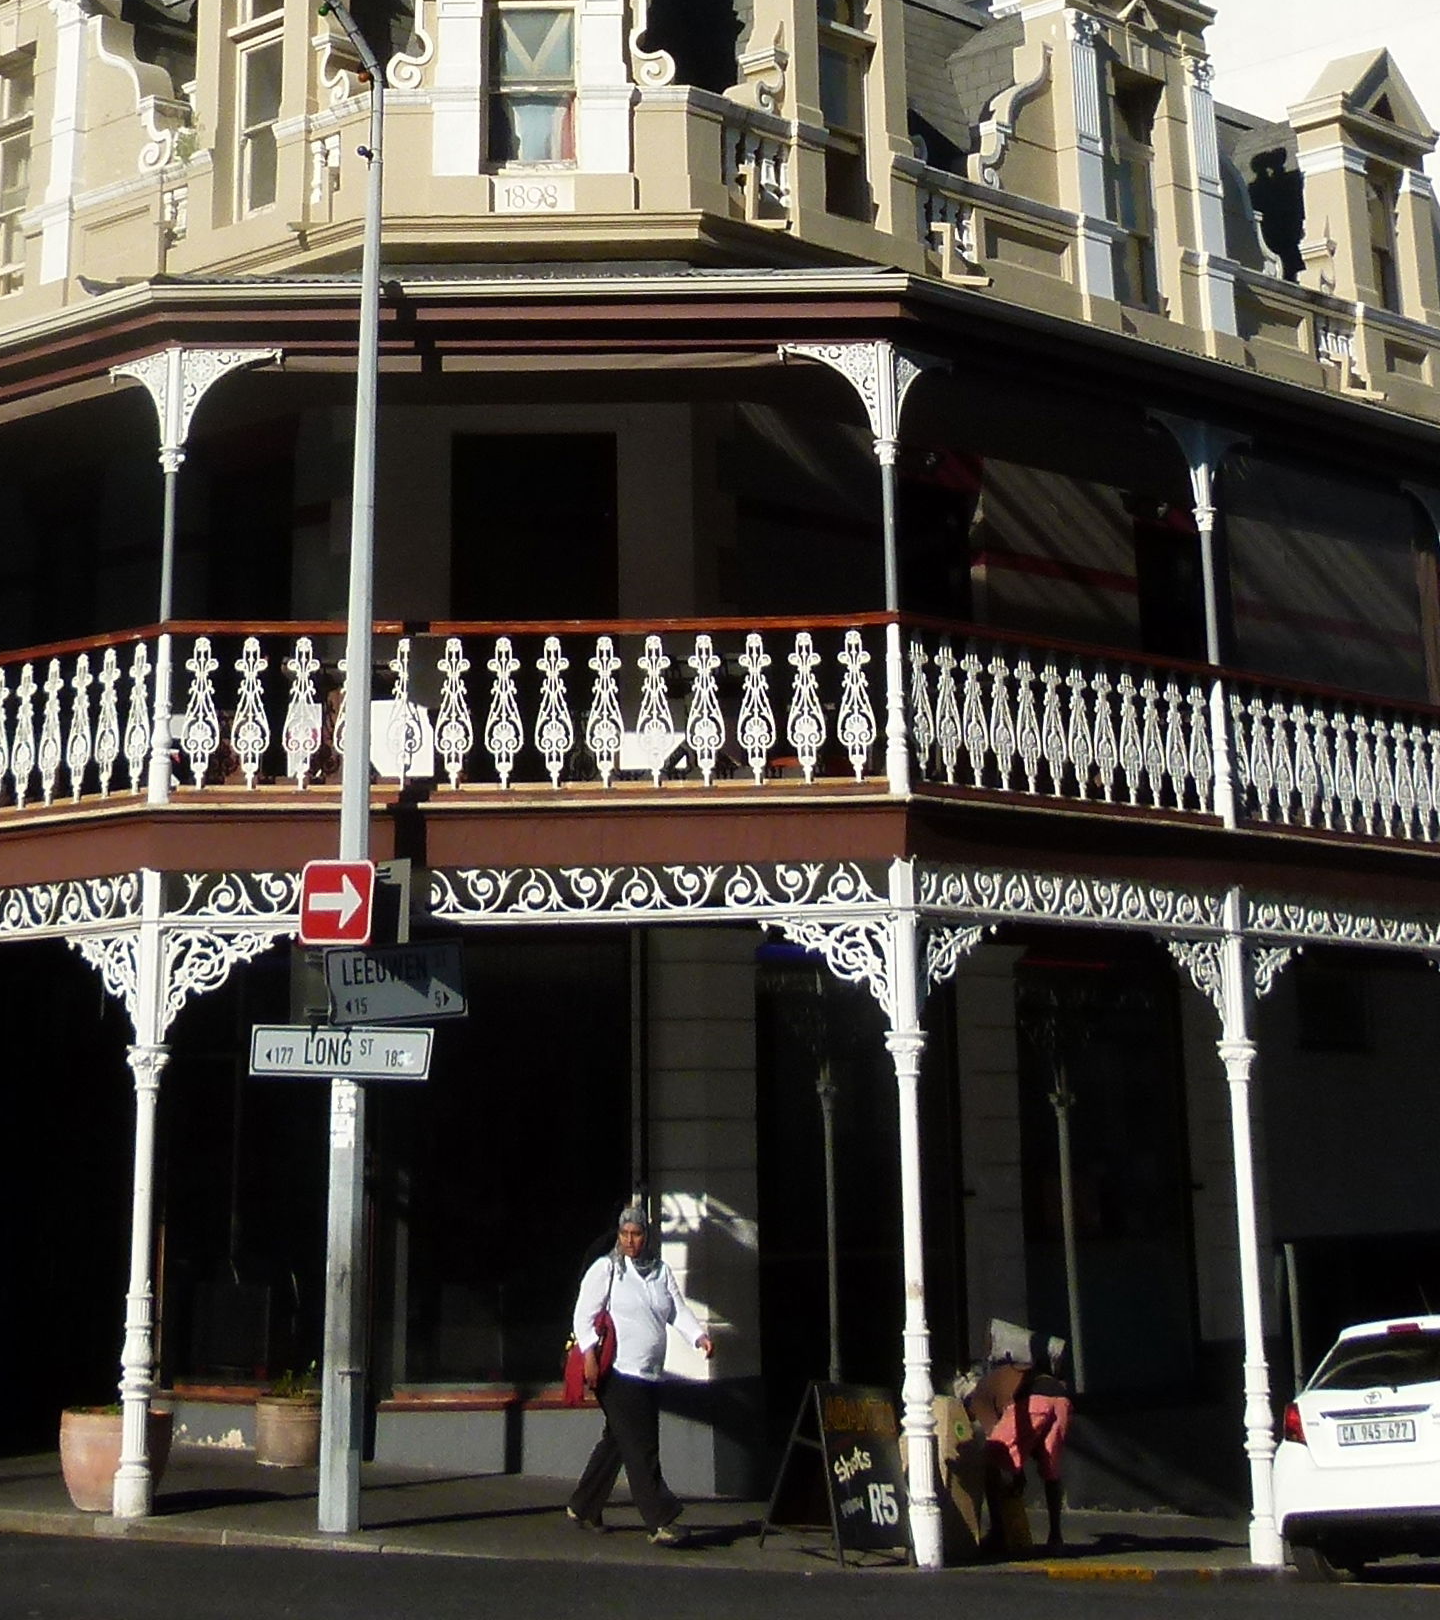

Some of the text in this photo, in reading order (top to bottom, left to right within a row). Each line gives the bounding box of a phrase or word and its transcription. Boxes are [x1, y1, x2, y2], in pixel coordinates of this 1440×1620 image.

[504, 185, 558, 210] 1898
[342, 953, 428, 986] LEEUWEN
[353, 991, 442, 1015] 15 5
[275, 1047, 294, 1064] 177
[304, 1037, 352, 1066] LONG
[360, 1038, 374, 1055] ST
[1343, 1427, 1356, 1442] CA
[834, 1446, 872, 1482] Shots
[867, 1482, 900, 1526] R5
